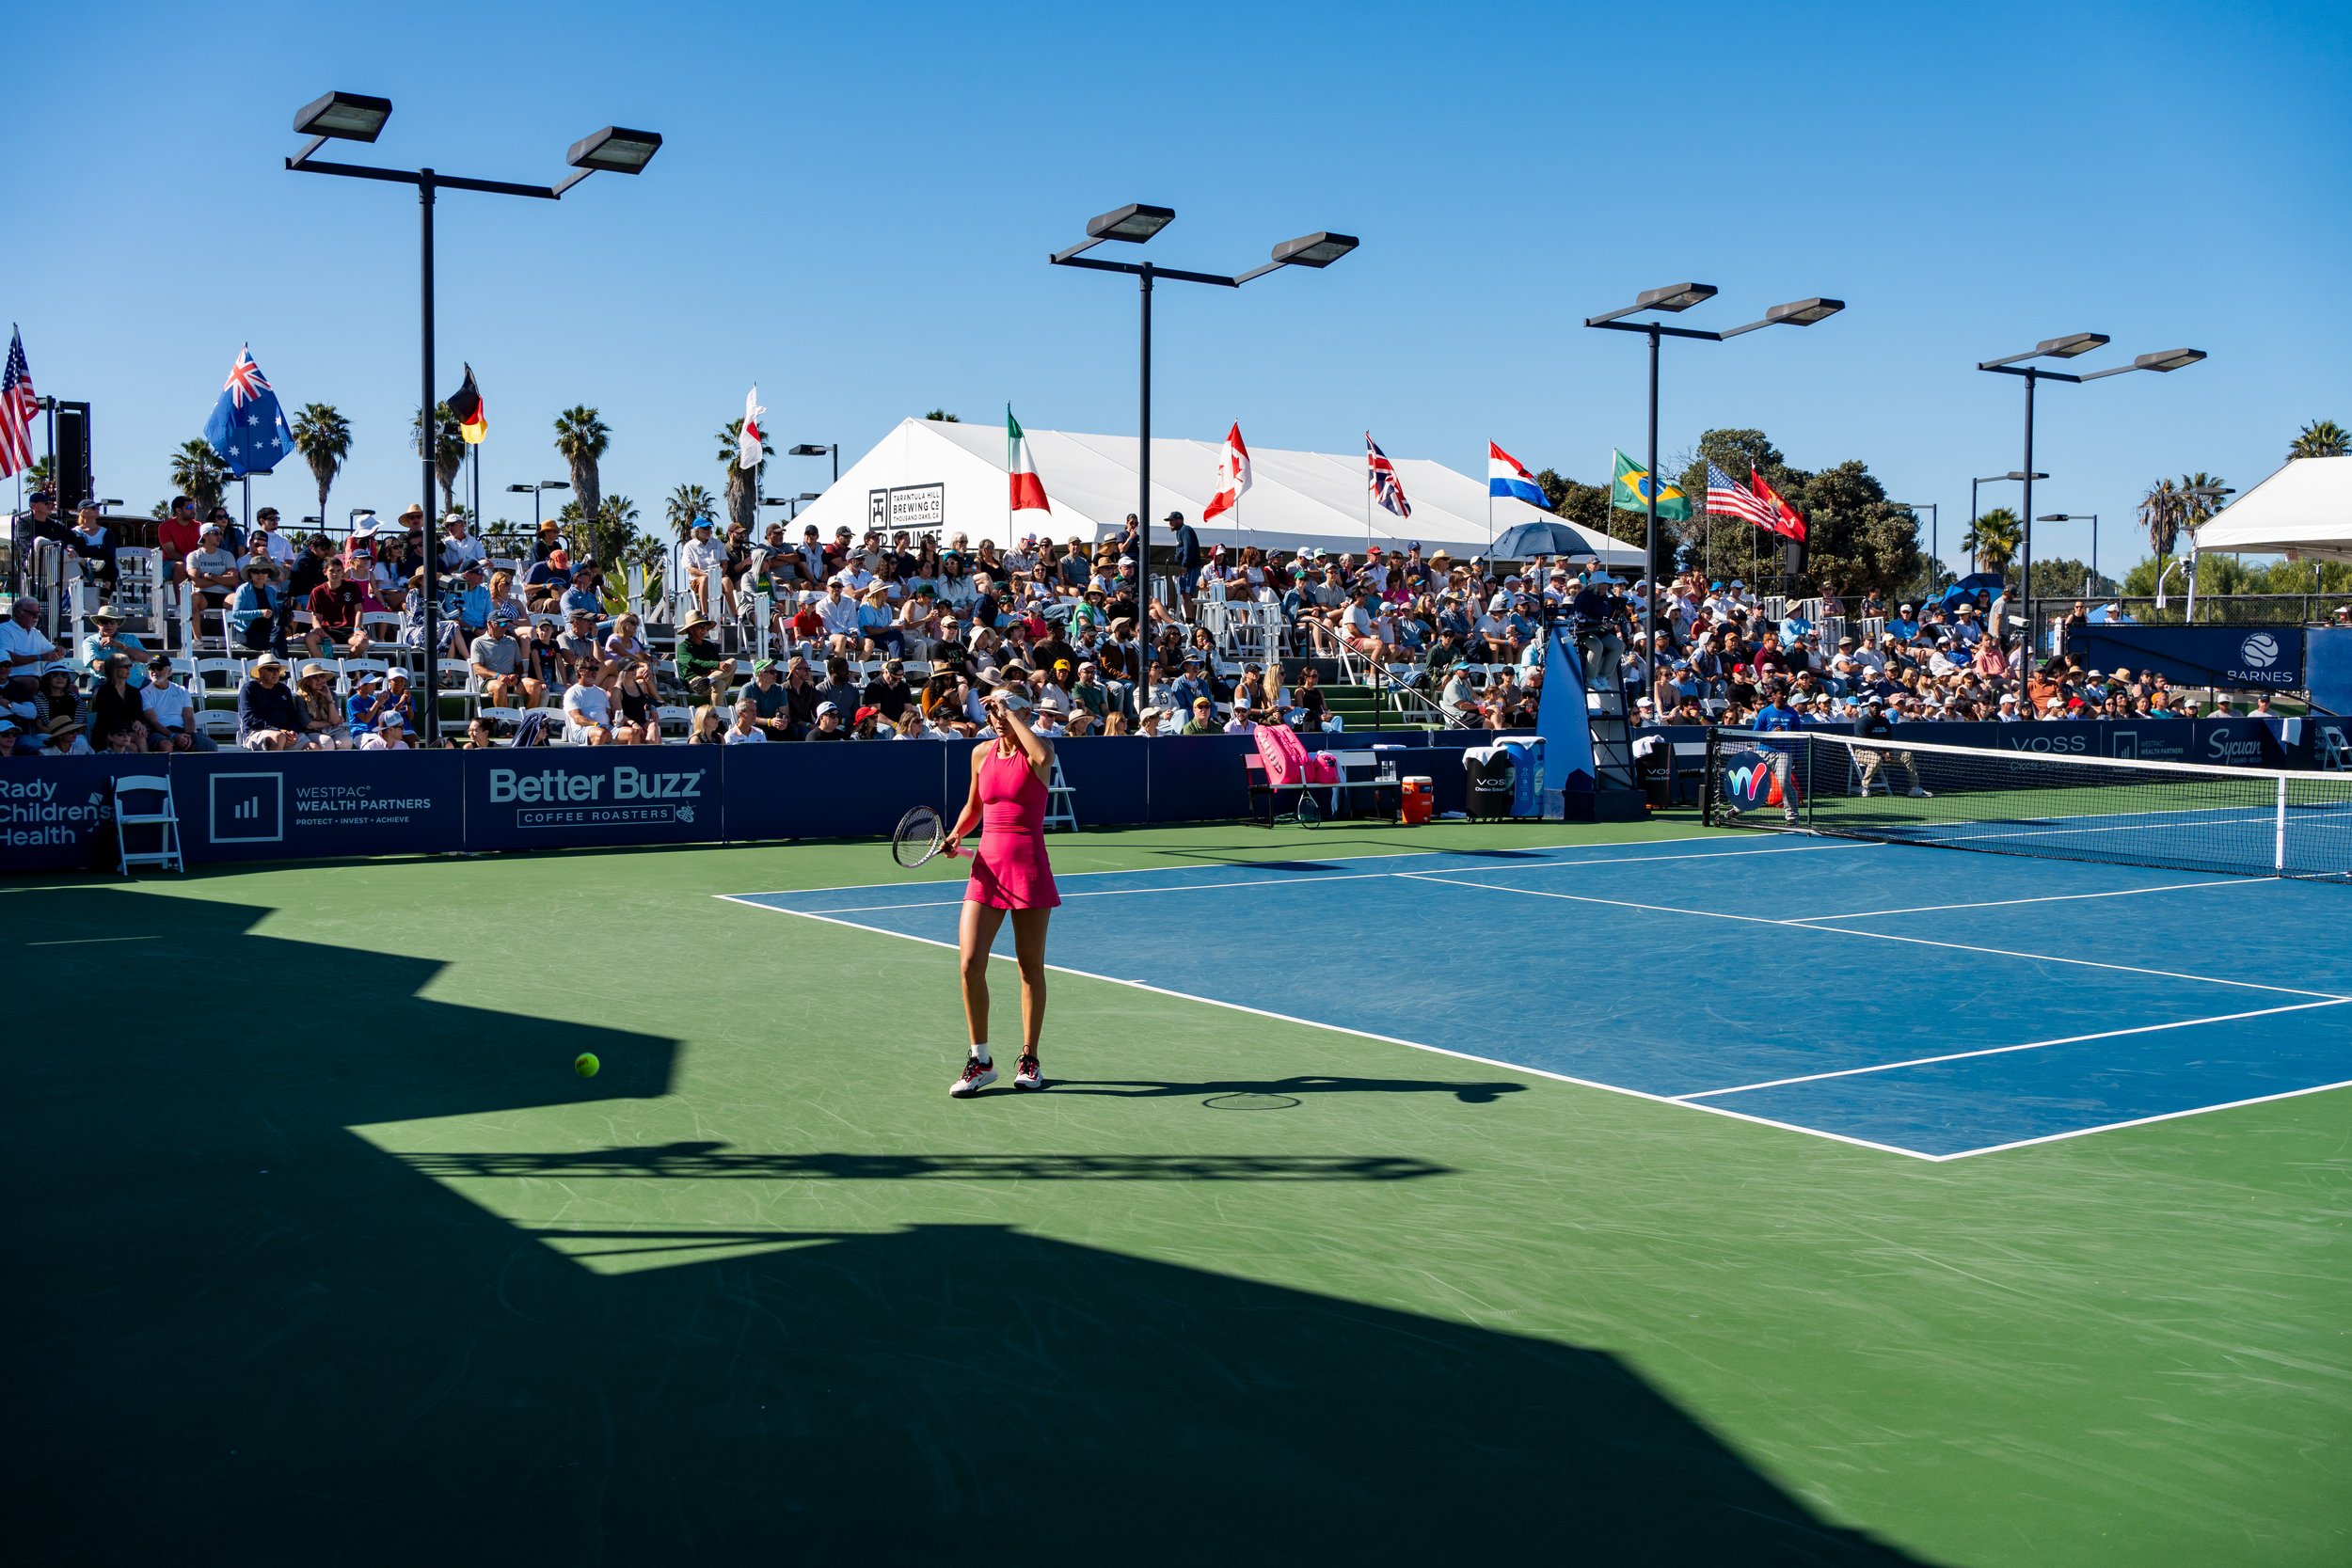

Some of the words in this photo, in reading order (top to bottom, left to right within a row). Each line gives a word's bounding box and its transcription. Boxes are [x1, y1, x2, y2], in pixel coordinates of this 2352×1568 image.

[894, 493, 926, 502] TARANTULA
[928, 491, 939, 499] HILL
[894, 501, 929, 514] BREWING
[2228, 670, 2294, 683] BARNES
[2208, 728, 2262, 765] Sycuan
[0, 779, 57, 801] Rady
[489, 768, 605, 803] Better
[296, 800, 356, 812] WEALTH
[360, 799, 431, 811] PARTNERS
[525, 813, 583, 823] COFFEE
[593, 809, 668, 821] ROASTERS
[0, 826, 75, 846] Health
